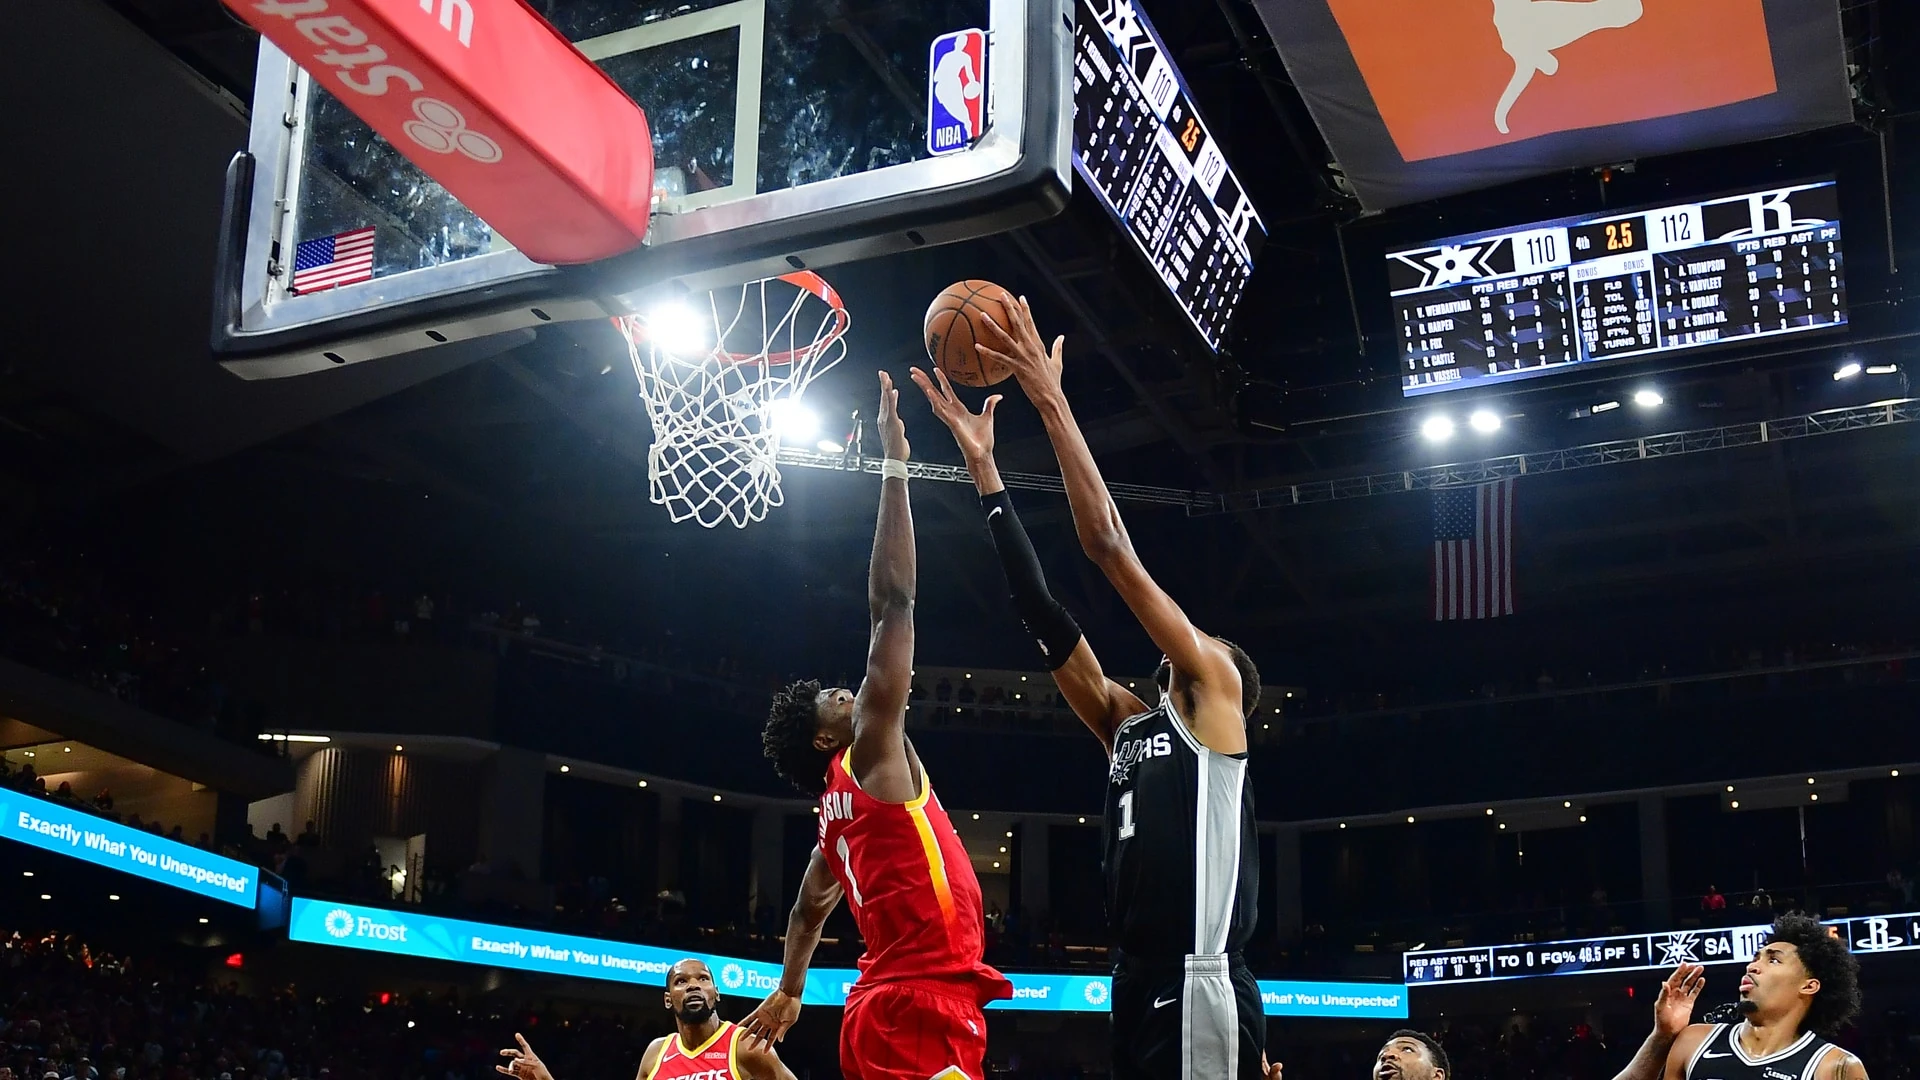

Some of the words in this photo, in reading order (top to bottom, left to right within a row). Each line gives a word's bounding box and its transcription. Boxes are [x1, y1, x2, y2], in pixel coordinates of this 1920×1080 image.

[1150, 67, 1172, 108] 110
[935, 124, 962, 149] NBA
[1201, 151, 1221, 188] 112
[1605, 222, 1633, 251] 2.5
[1660, 212, 1691, 244] 112
[1736, 240, 1761, 253] PTS
[1762, 236, 1787, 249] REB
[1790, 231, 1814, 245] AST
[1820, 227, 1837, 240] PF
[1526, 234, 1556, 266] 110
[1663, 267, 1669, 279] 1
[1801, 245, 1808, 258] 4
[1827, 241, 1835, 254] 3
[1577, 266, 1598, 279] BONUS
[1623, 258, 1645, 271] BONUS
[1775, 266, 1783, 280] 2
[1828, 258, 1836, 271] 2
[1471, 283, 1495, 295] PTS
[1496, 279, 1519, 291] REB
[1522, 275, 1545, 287] AST
[1550, 271, 1566, 283] PF
[1666, 300, 1673, 313] 7
[1776, 283, 1784, 297] 7
[1830, 275, 1838, 289] 2
[1403, 309, 1409, 321] 1
[1479, 296, 1491, 309] 25
[1532, 288, 1539, 300] 2
[1556, 284, 1563, 296] 4
[1508, 308, 1515, 321] 3
[1534, 304, 1541, 317] 2
[1560, 301, 1566, 313] 1
[1751, 305, 1759, 318] 7
[1806, 297, 1812, 310] 1
[1831, 293, 1839, 306] 4
[1511, 325, 1517, 337] 4
[1561, 317, 1567, 330] 1
[1807, 314, 1813, 326] 1
[1408, 358, 1416, 370] 5
[1430, 352, 1456, 367] CASTLE
[1486, 345, 1496, 358] 15
[1512, 342, 1518, 354] 7
[1562, 334, 1569, 347] 5
[1564, 350, 1570, 362] 4
[1602, 337, 1636, 350] TURNS
[1118, 790, 1136, 841] 1
[17, 811, 82, 846] Exactly
[84, 831, 127, 857] What
[129, 844, 157, 868] You
[836, 834, 863, 908] 1
[356, 916, 408, 943] Frost
[471, 936, 529, 959] Exactly
[530, 944, 570, 961] What
[572, 949, 599, 965] You
[1497, 954, 1520, 968] TO
[1526, 951, 1534, 967] 0
[1540, 950, 1576, 966] FG%
[1604, 946, 1626, 961] PF
[1632, 943, 1641, 959] 5
[1704, 936, 1732, 956] SA
[1409, 958, 1429, 967] REB
[1429, 956, 1449, 966] AST
[1450, 955, 1468, 965] STL
[1413, 966, 1425, 979] 47
[1434, 964, 1445, 978] 21
[1453, 963, 1464, 977] 10
[1474, 961, 1482, 975] 3
[747, 969, 780, 990] Fros
[1261, 992, 1294, 1005] What
[1295, 993, 1320, 1005] You
